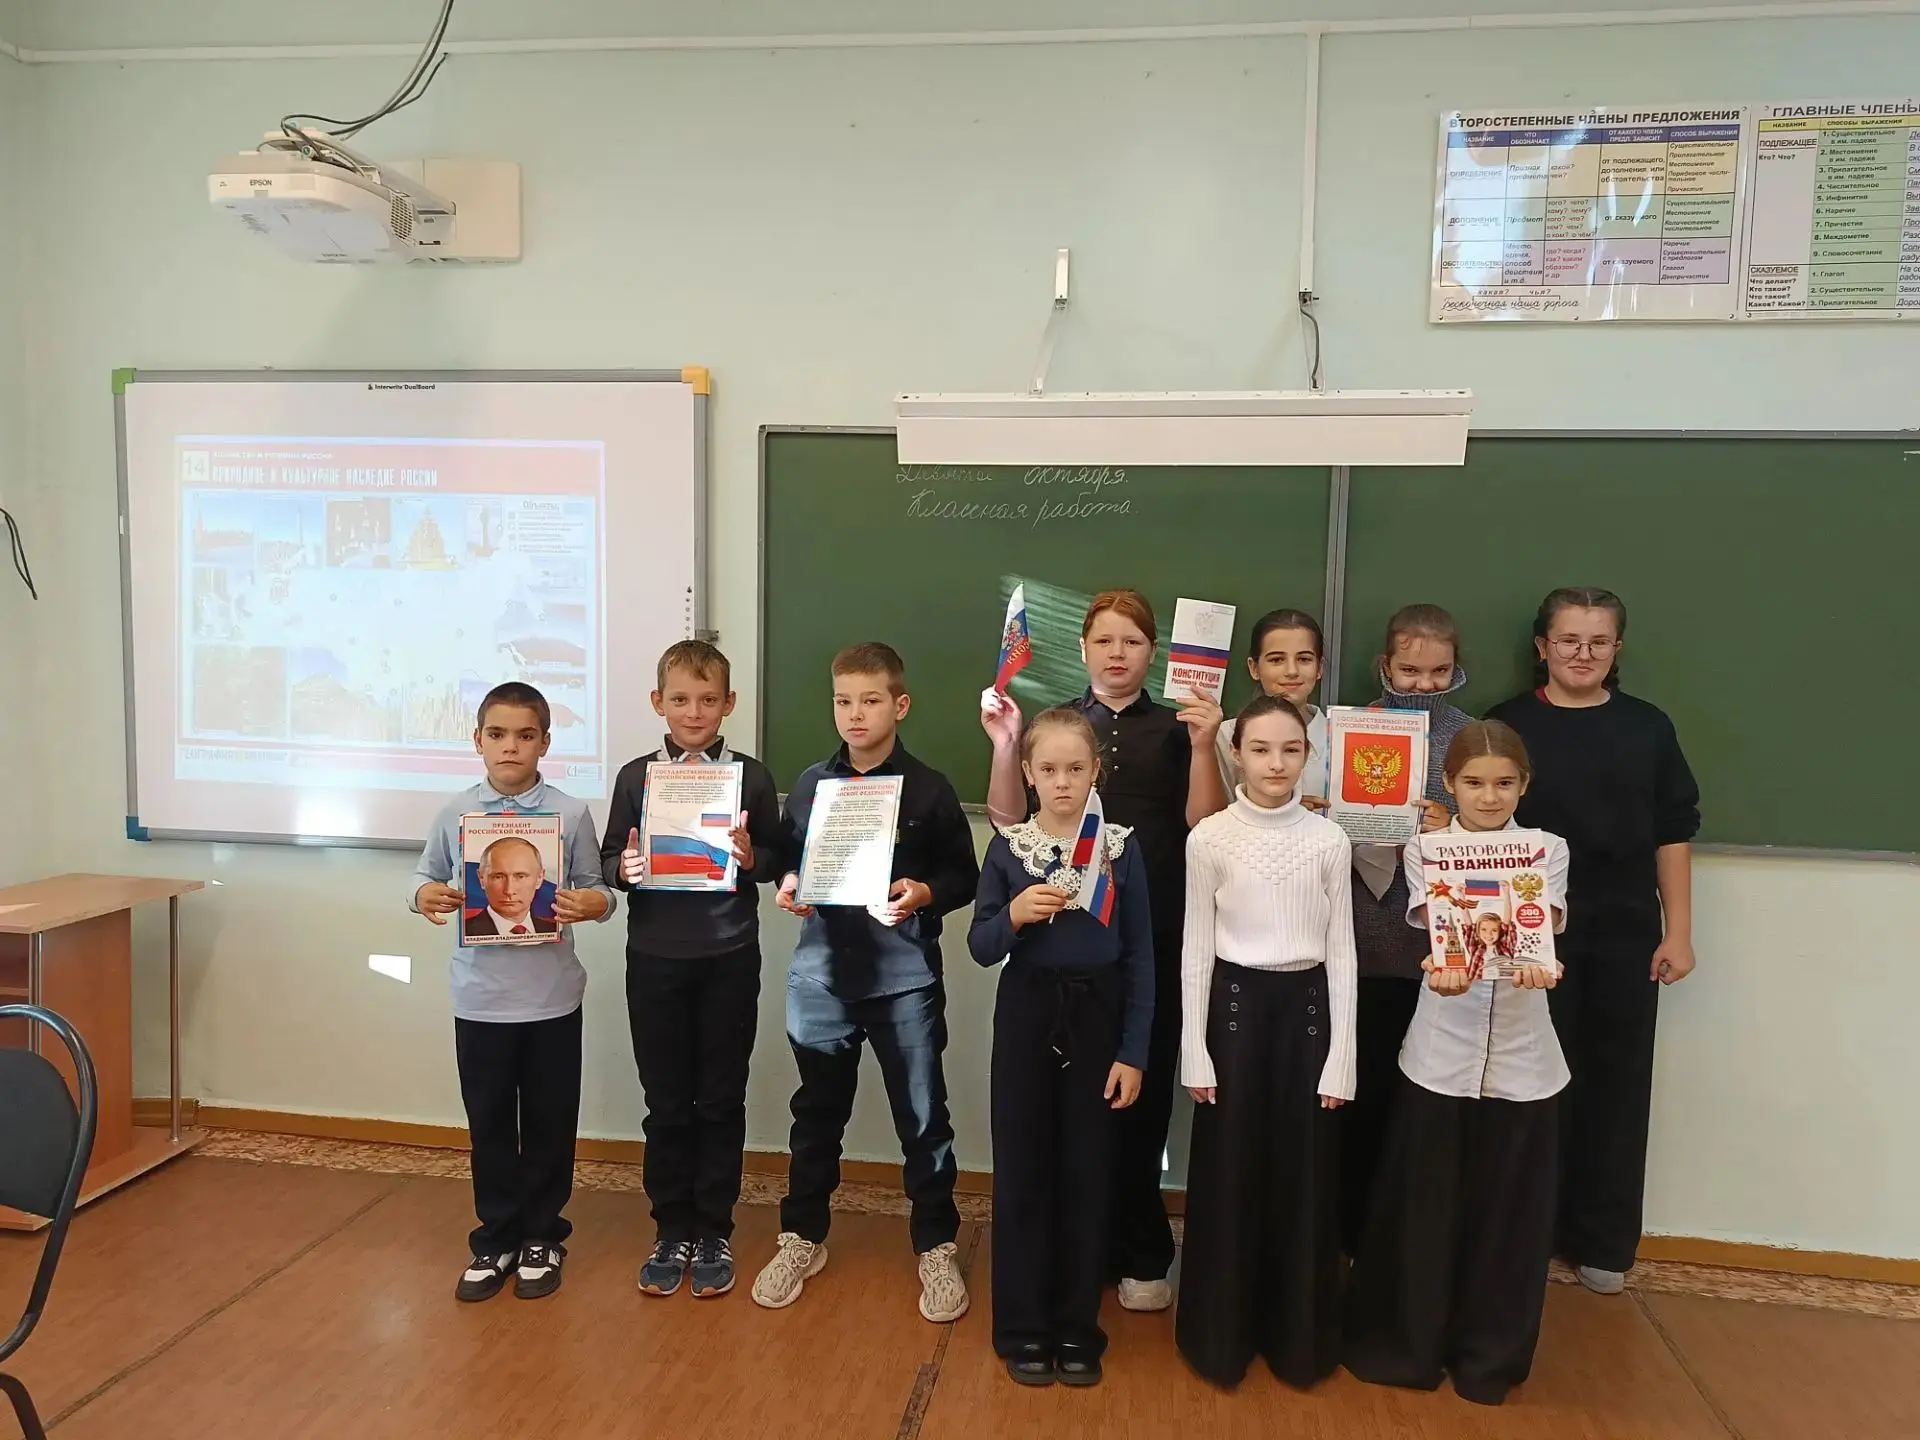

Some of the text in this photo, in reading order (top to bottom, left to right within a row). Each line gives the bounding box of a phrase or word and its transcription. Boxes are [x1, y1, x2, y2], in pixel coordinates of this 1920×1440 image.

[1773, 105, 1855, 117] ГЛАВНЫЕ
[1450, 109, 1740, 128] ВТОРОСТЕПЕННЫЕ ЧЛЕНЫ ПРЕДЛОЖЕНИЯ
[1463, 135, 1495, 143] НАЗВАНИЕ
[1831, 130, 1896, 138] Существительное
[1759, 138, 1817, 148] ПОДЛЕЖАЩЕЕ
[1511, 300, 1541, 308] наша
[183, 457, 207, 479] 14
[400, 467, 438, 487] РОССИИ
[1172, 667, 1221, 682] КОНСТИТУЦИЯ
[1436, 843, 1530, 858] РАЗГОВОРЫ
[1439, 857, 1532, 871] О ВАЖНОМ
[1520, 908, 1539, 916] 300
